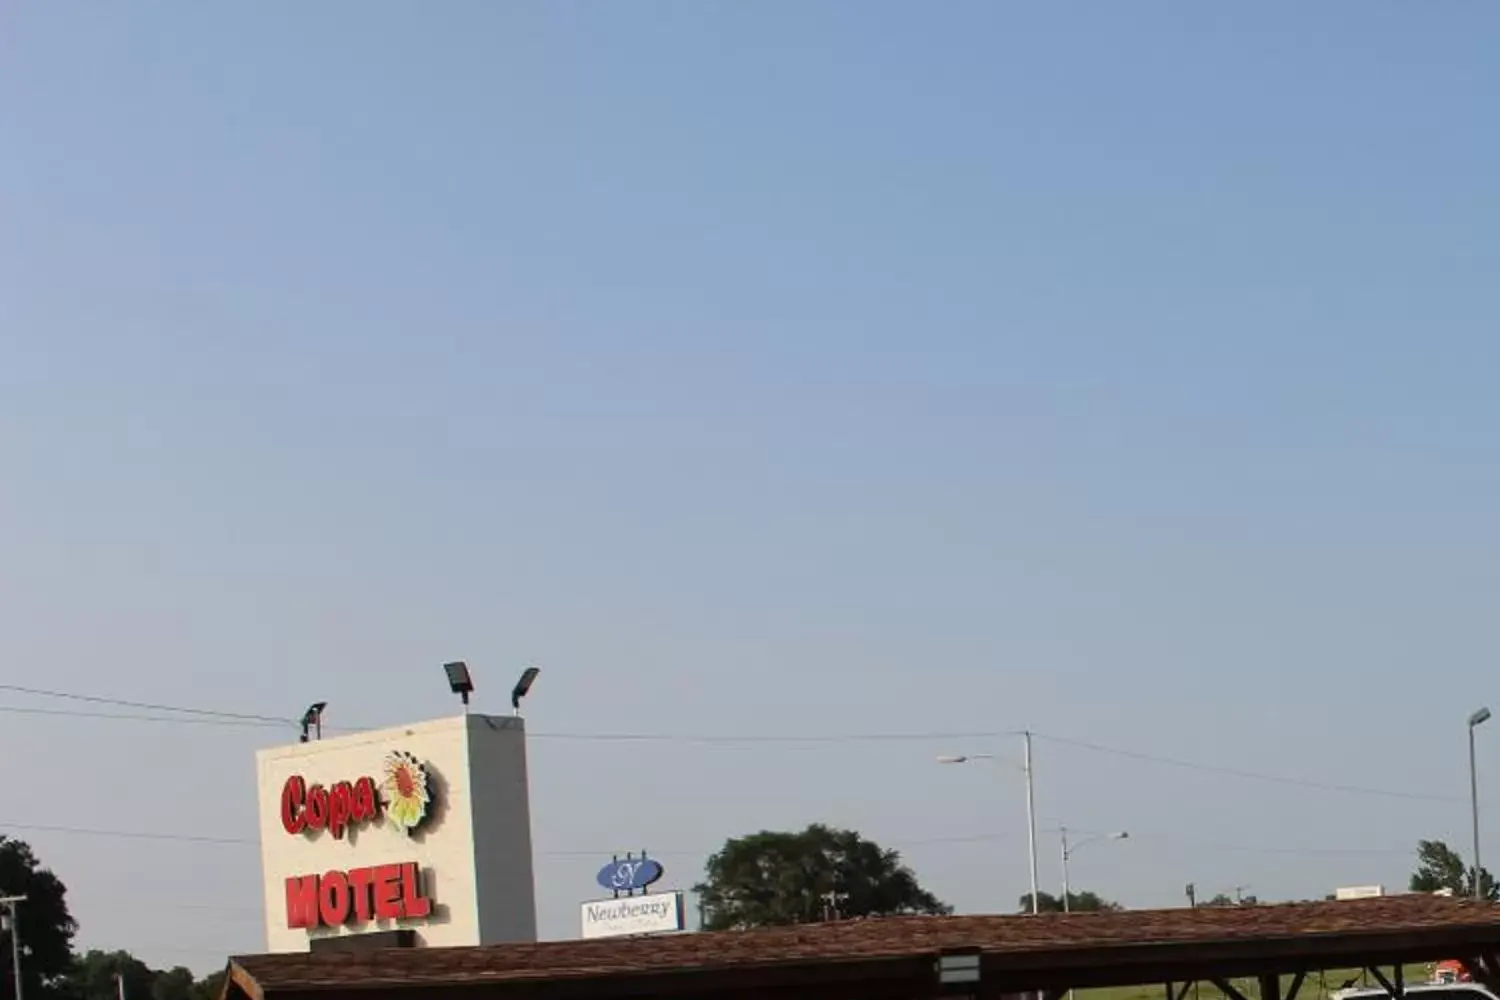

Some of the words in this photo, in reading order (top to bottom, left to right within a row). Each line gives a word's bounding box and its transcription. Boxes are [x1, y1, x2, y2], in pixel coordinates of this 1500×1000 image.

[281, 775, 378, 839] Copa
[285, 861, 430, 929] MOTEL
[587, 901, 671, 922] Newberry
